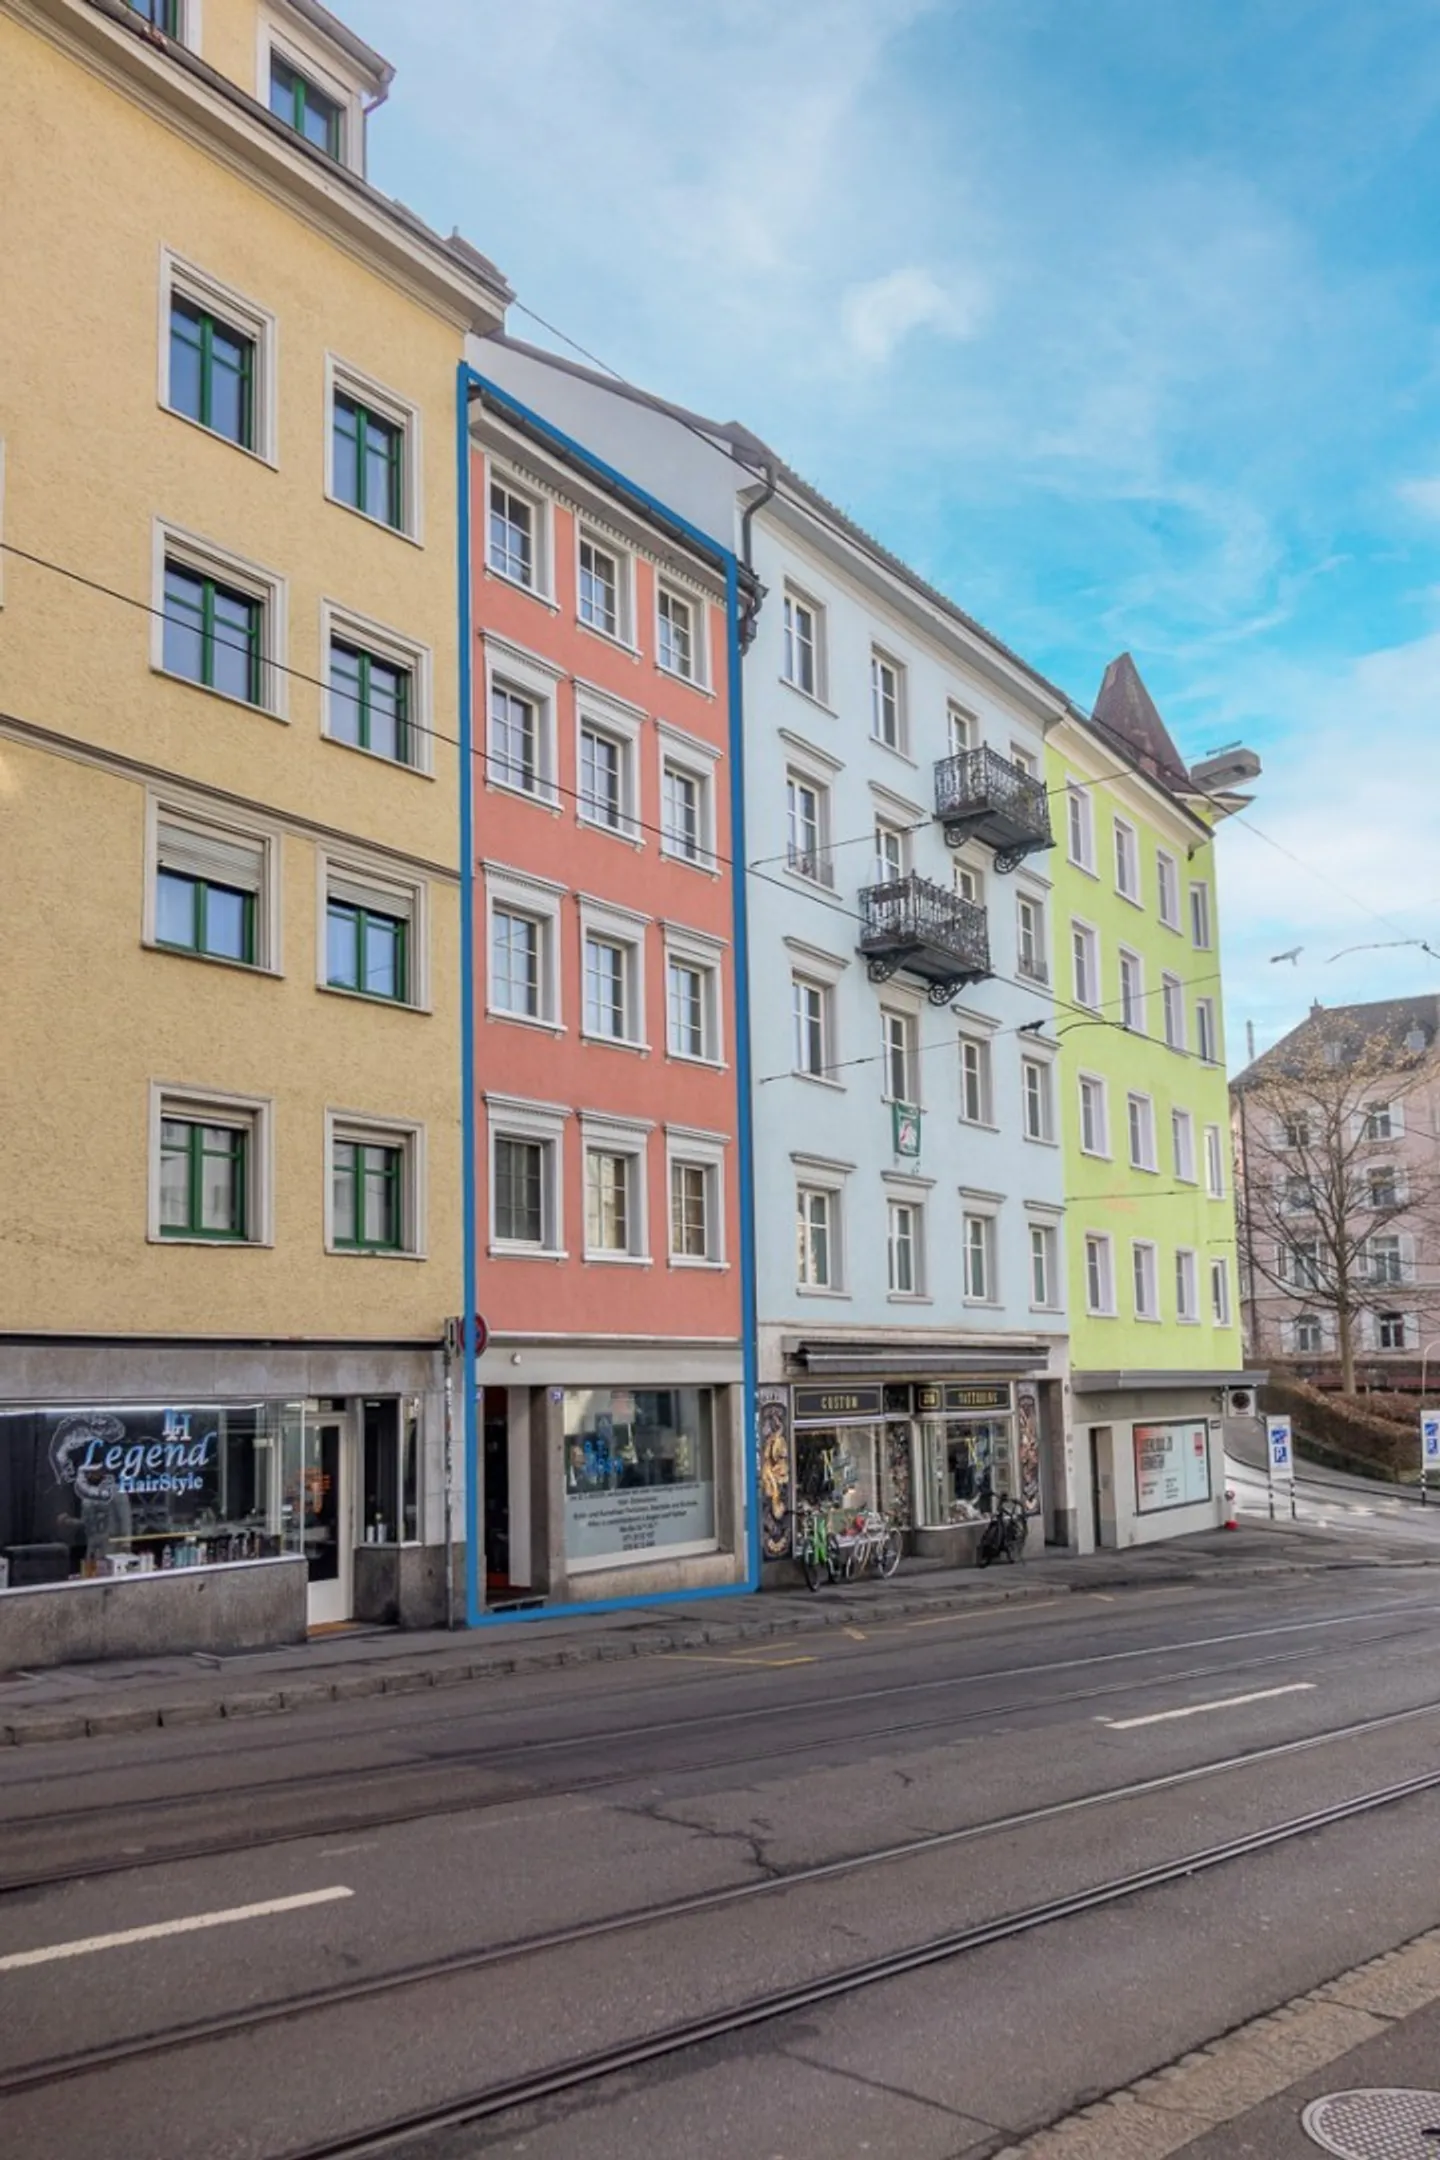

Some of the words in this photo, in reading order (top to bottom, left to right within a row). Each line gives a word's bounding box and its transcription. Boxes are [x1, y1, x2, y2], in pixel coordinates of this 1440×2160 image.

[821, 1396, 859, 1409] CUSTOM
[78, 1431, 217, 1480] Legend
[117, 1472, 204, 1496] HairStyle
